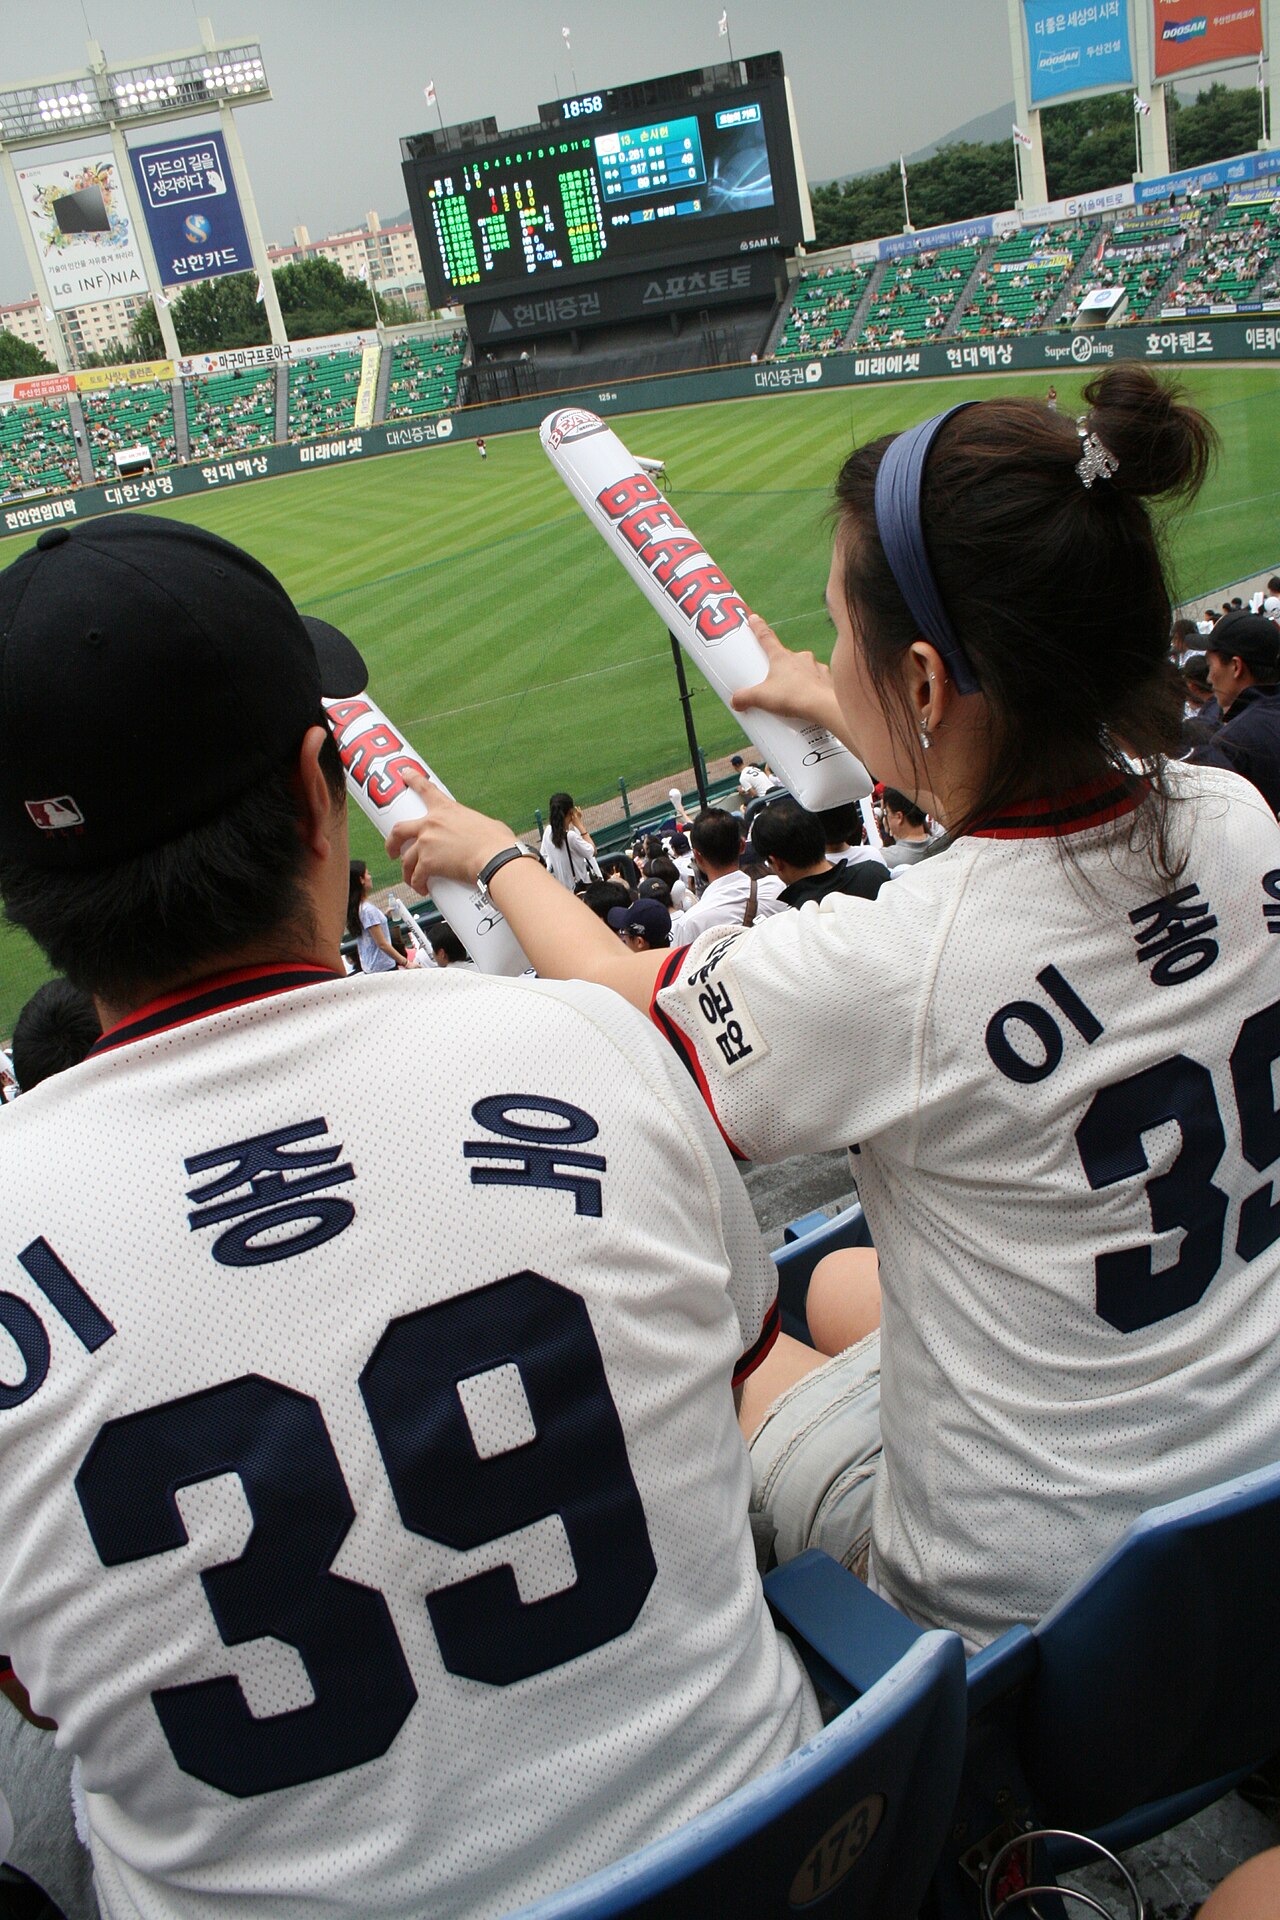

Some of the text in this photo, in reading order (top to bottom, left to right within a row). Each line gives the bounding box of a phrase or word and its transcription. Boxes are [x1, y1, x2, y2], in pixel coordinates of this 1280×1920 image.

[1067, 6, 1097, 28] 세상의
[1099, 1, 1120, 20] 시작
[1162, 19, 1207, 41] DOOSAN
[1039, 50, 1079, 69] DOOSAN
[562, 95, 603, 119] 18:58
[148, 152, 214, 178] 카드의 길을
[630, 162, 647, 175] 317
[688, 167, 696, 178] 0
[152, 173, 204, 197] 생각하다
[643, 208, 654, 221] 27
[748, 235, 781, 250] SAM IK
[171, 247, 239, 276] 신한카드
[53, 283, 73, 296] LG
[642, 265, 752, 305] 스포츠토토
[513, 292, 600, 328] 현대증권
[1145, 331, 1214, 355] 호야렌즈
[1245, 327, 1280, 351] 이트레
[219, 345, 293, 369] 마구마구프로야구
[855, 353, 920, 377] 미래에셋
[946, 344, 1013, 368] 현대해상
[1045, 345, 1071, 362] Super
[754, 368, 805, 388] 대신증권
[386, 424, 437, 446] 대신증권
[300, 437, 363, 463] 미래에셋
[202, 456, 268, 485] 현대해상
[105, 476, 174, 505] 대한생명
[5, 498, 77, 530] 천안연암대학
[596, 473, 752, 647] BEARS
[74, 1269, 657, 1798] 39
[808, 1806, 868, 1892] 173
